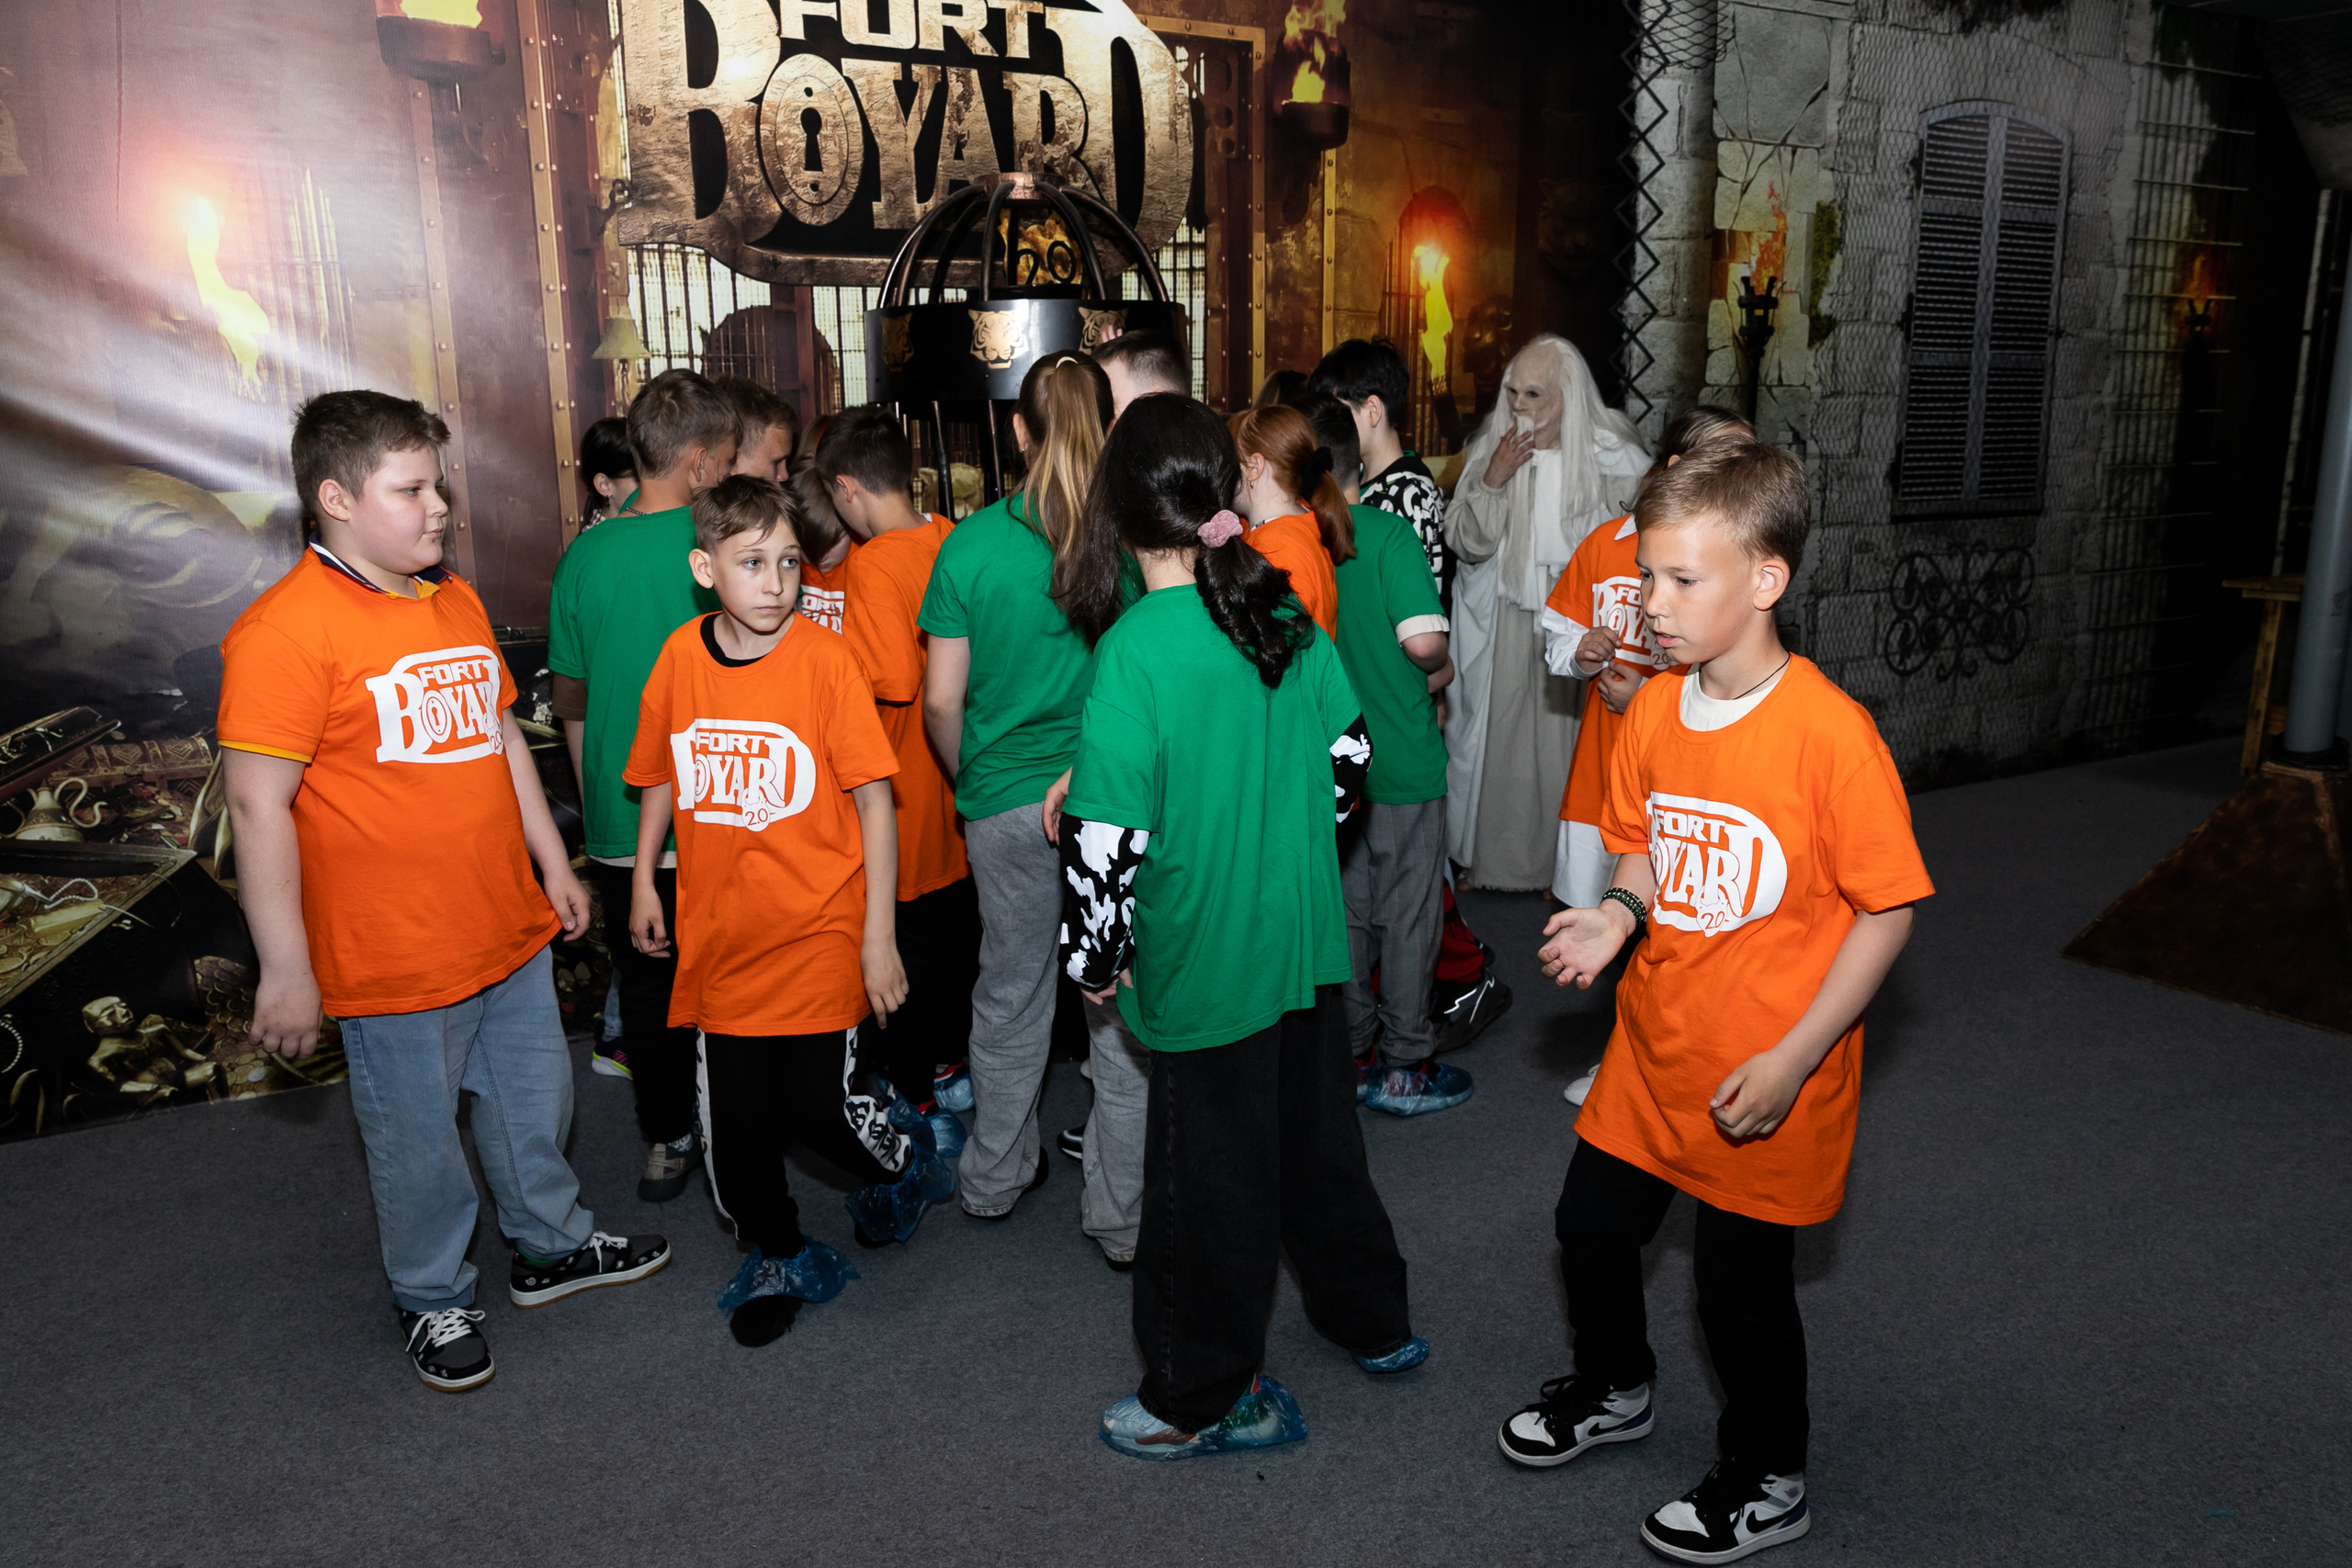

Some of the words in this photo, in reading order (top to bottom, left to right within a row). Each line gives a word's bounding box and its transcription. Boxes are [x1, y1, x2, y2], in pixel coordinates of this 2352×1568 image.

[1615, 586, 1642, 605] FO
[417, 659, 483, 688] FORT
[695, 732, 765, 754] FORT
[745, 808, 769, 826] 2.0
[1654, 808, 1726, 843] FORT
